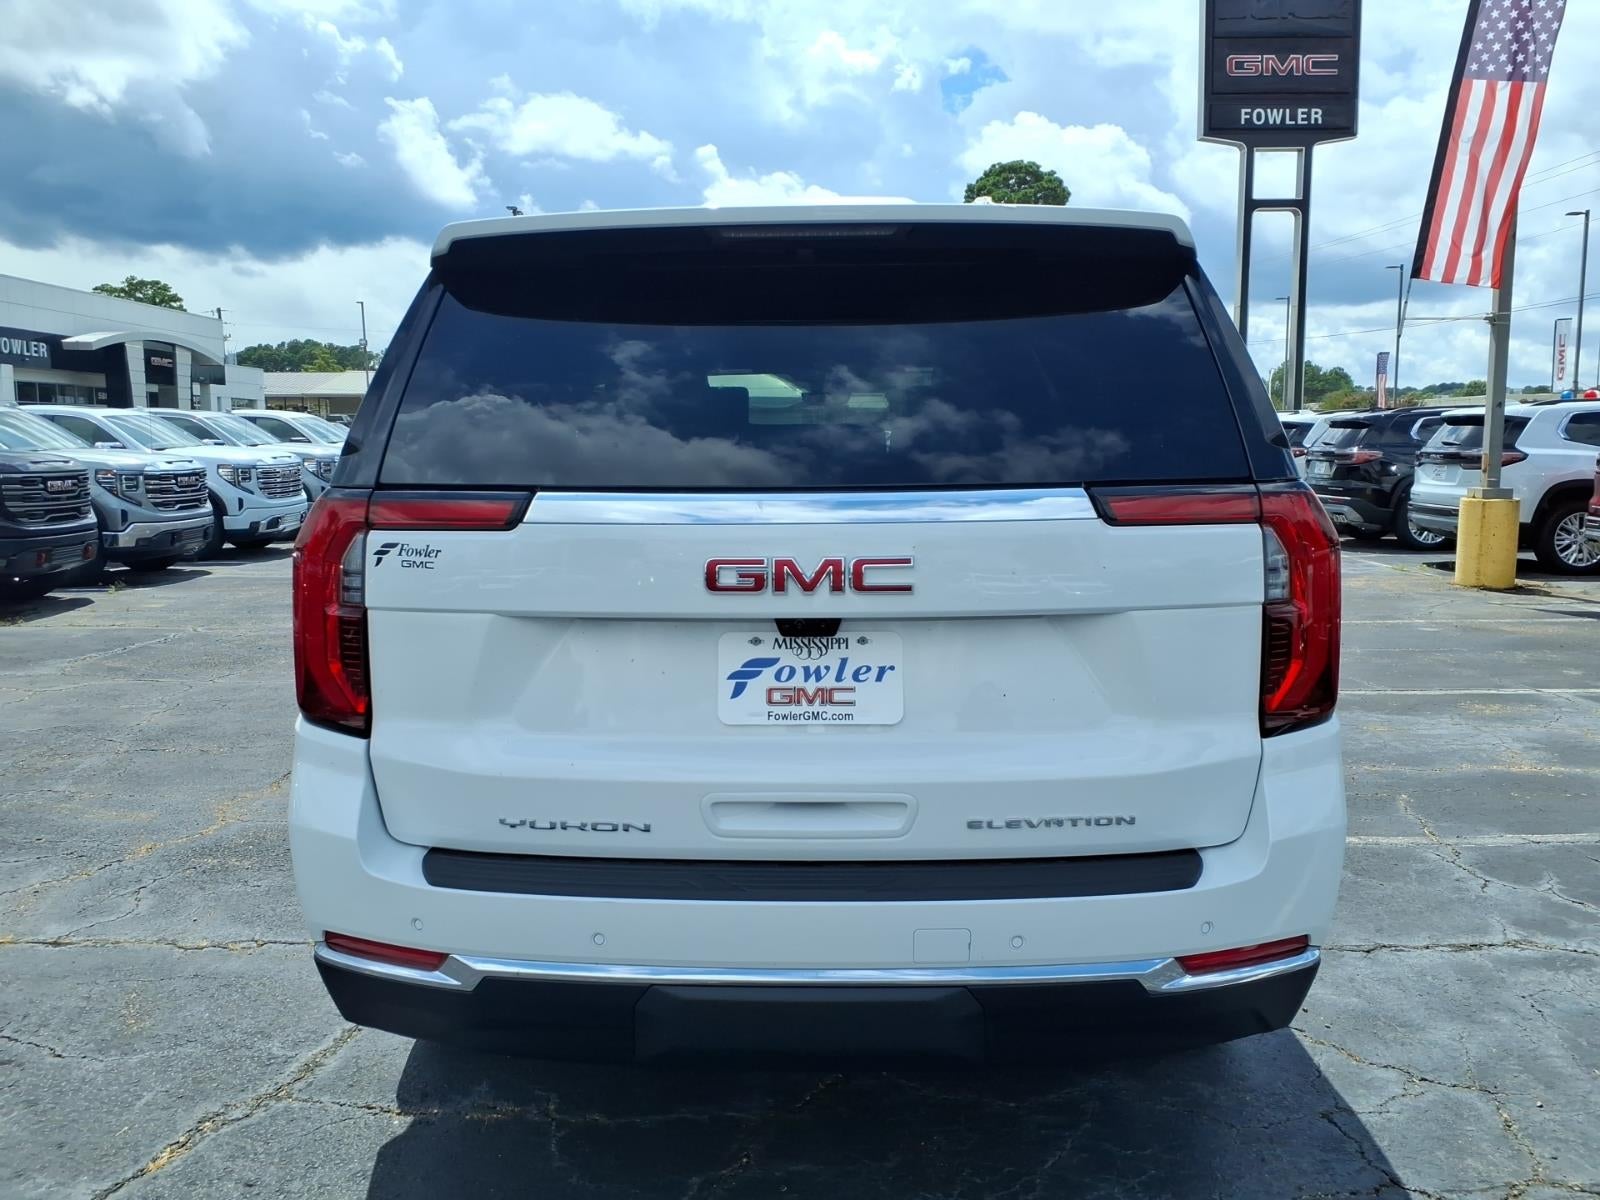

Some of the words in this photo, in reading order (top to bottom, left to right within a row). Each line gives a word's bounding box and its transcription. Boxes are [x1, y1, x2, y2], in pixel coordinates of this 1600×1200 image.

[1227, 54, 1339, 76] GMC
[1240, 108, 1323, 125] FOWLER
[0, 336, 48, 359] OWLER
[1557, 334, 1567, 380] GMC
[397, 543, 441, 558] Fowler
[401, 559, 435, 569] GMC
[704, 556, 914, 595] GMC
[772, 636, 849, 660] MISSISSIPPI
[726, 657, 896, 699] Fowler
[766, 687, 856, 706] GMC
[767, 711, 854, 721] FowlerGMC.com
[498, 817, 652, 833] YUKON
[967, 815, 1136, 830] ELEVATION
